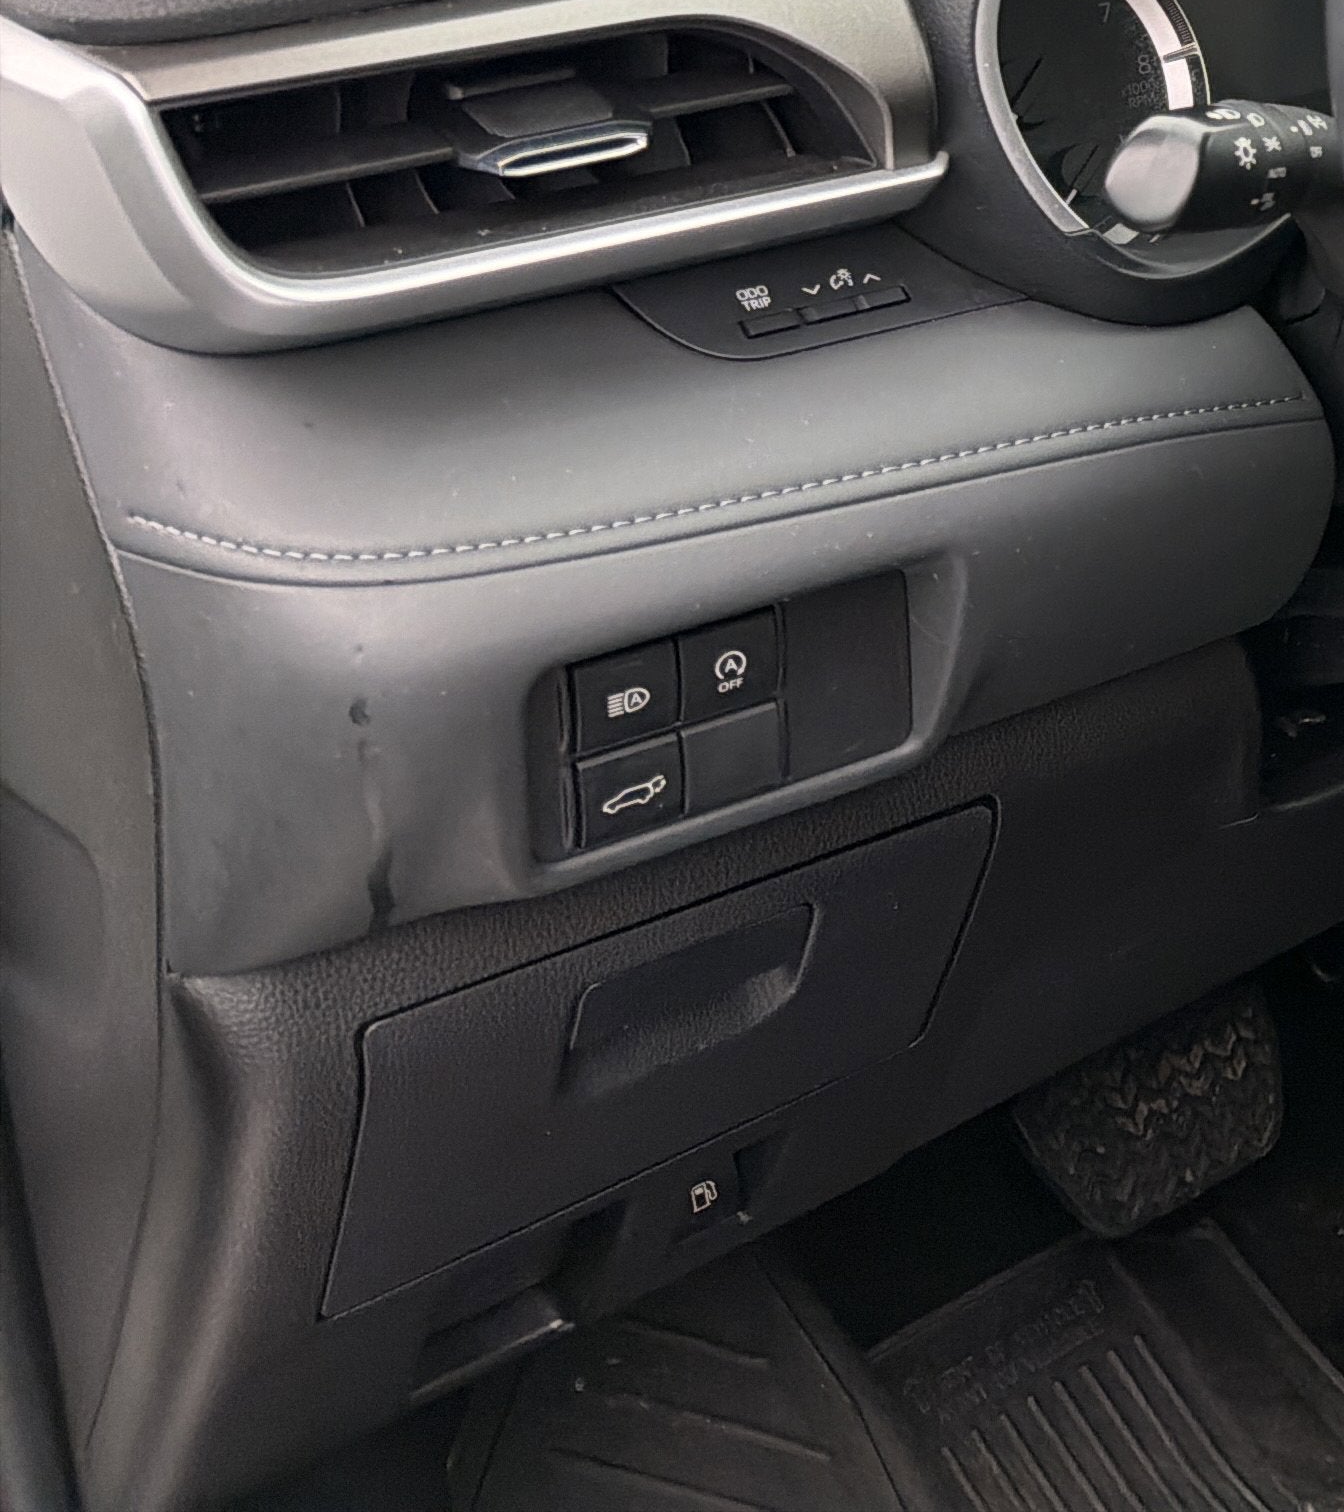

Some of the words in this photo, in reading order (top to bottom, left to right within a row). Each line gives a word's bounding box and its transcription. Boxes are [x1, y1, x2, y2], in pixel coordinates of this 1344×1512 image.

[1098, 1, 1111, 23] 7
[1137, 54, 1151, 75] 8
[735, 285, 769, 301] ODO
[740, 296, 772, 312] TRIP
[717, 677, 745, 693] OFF
